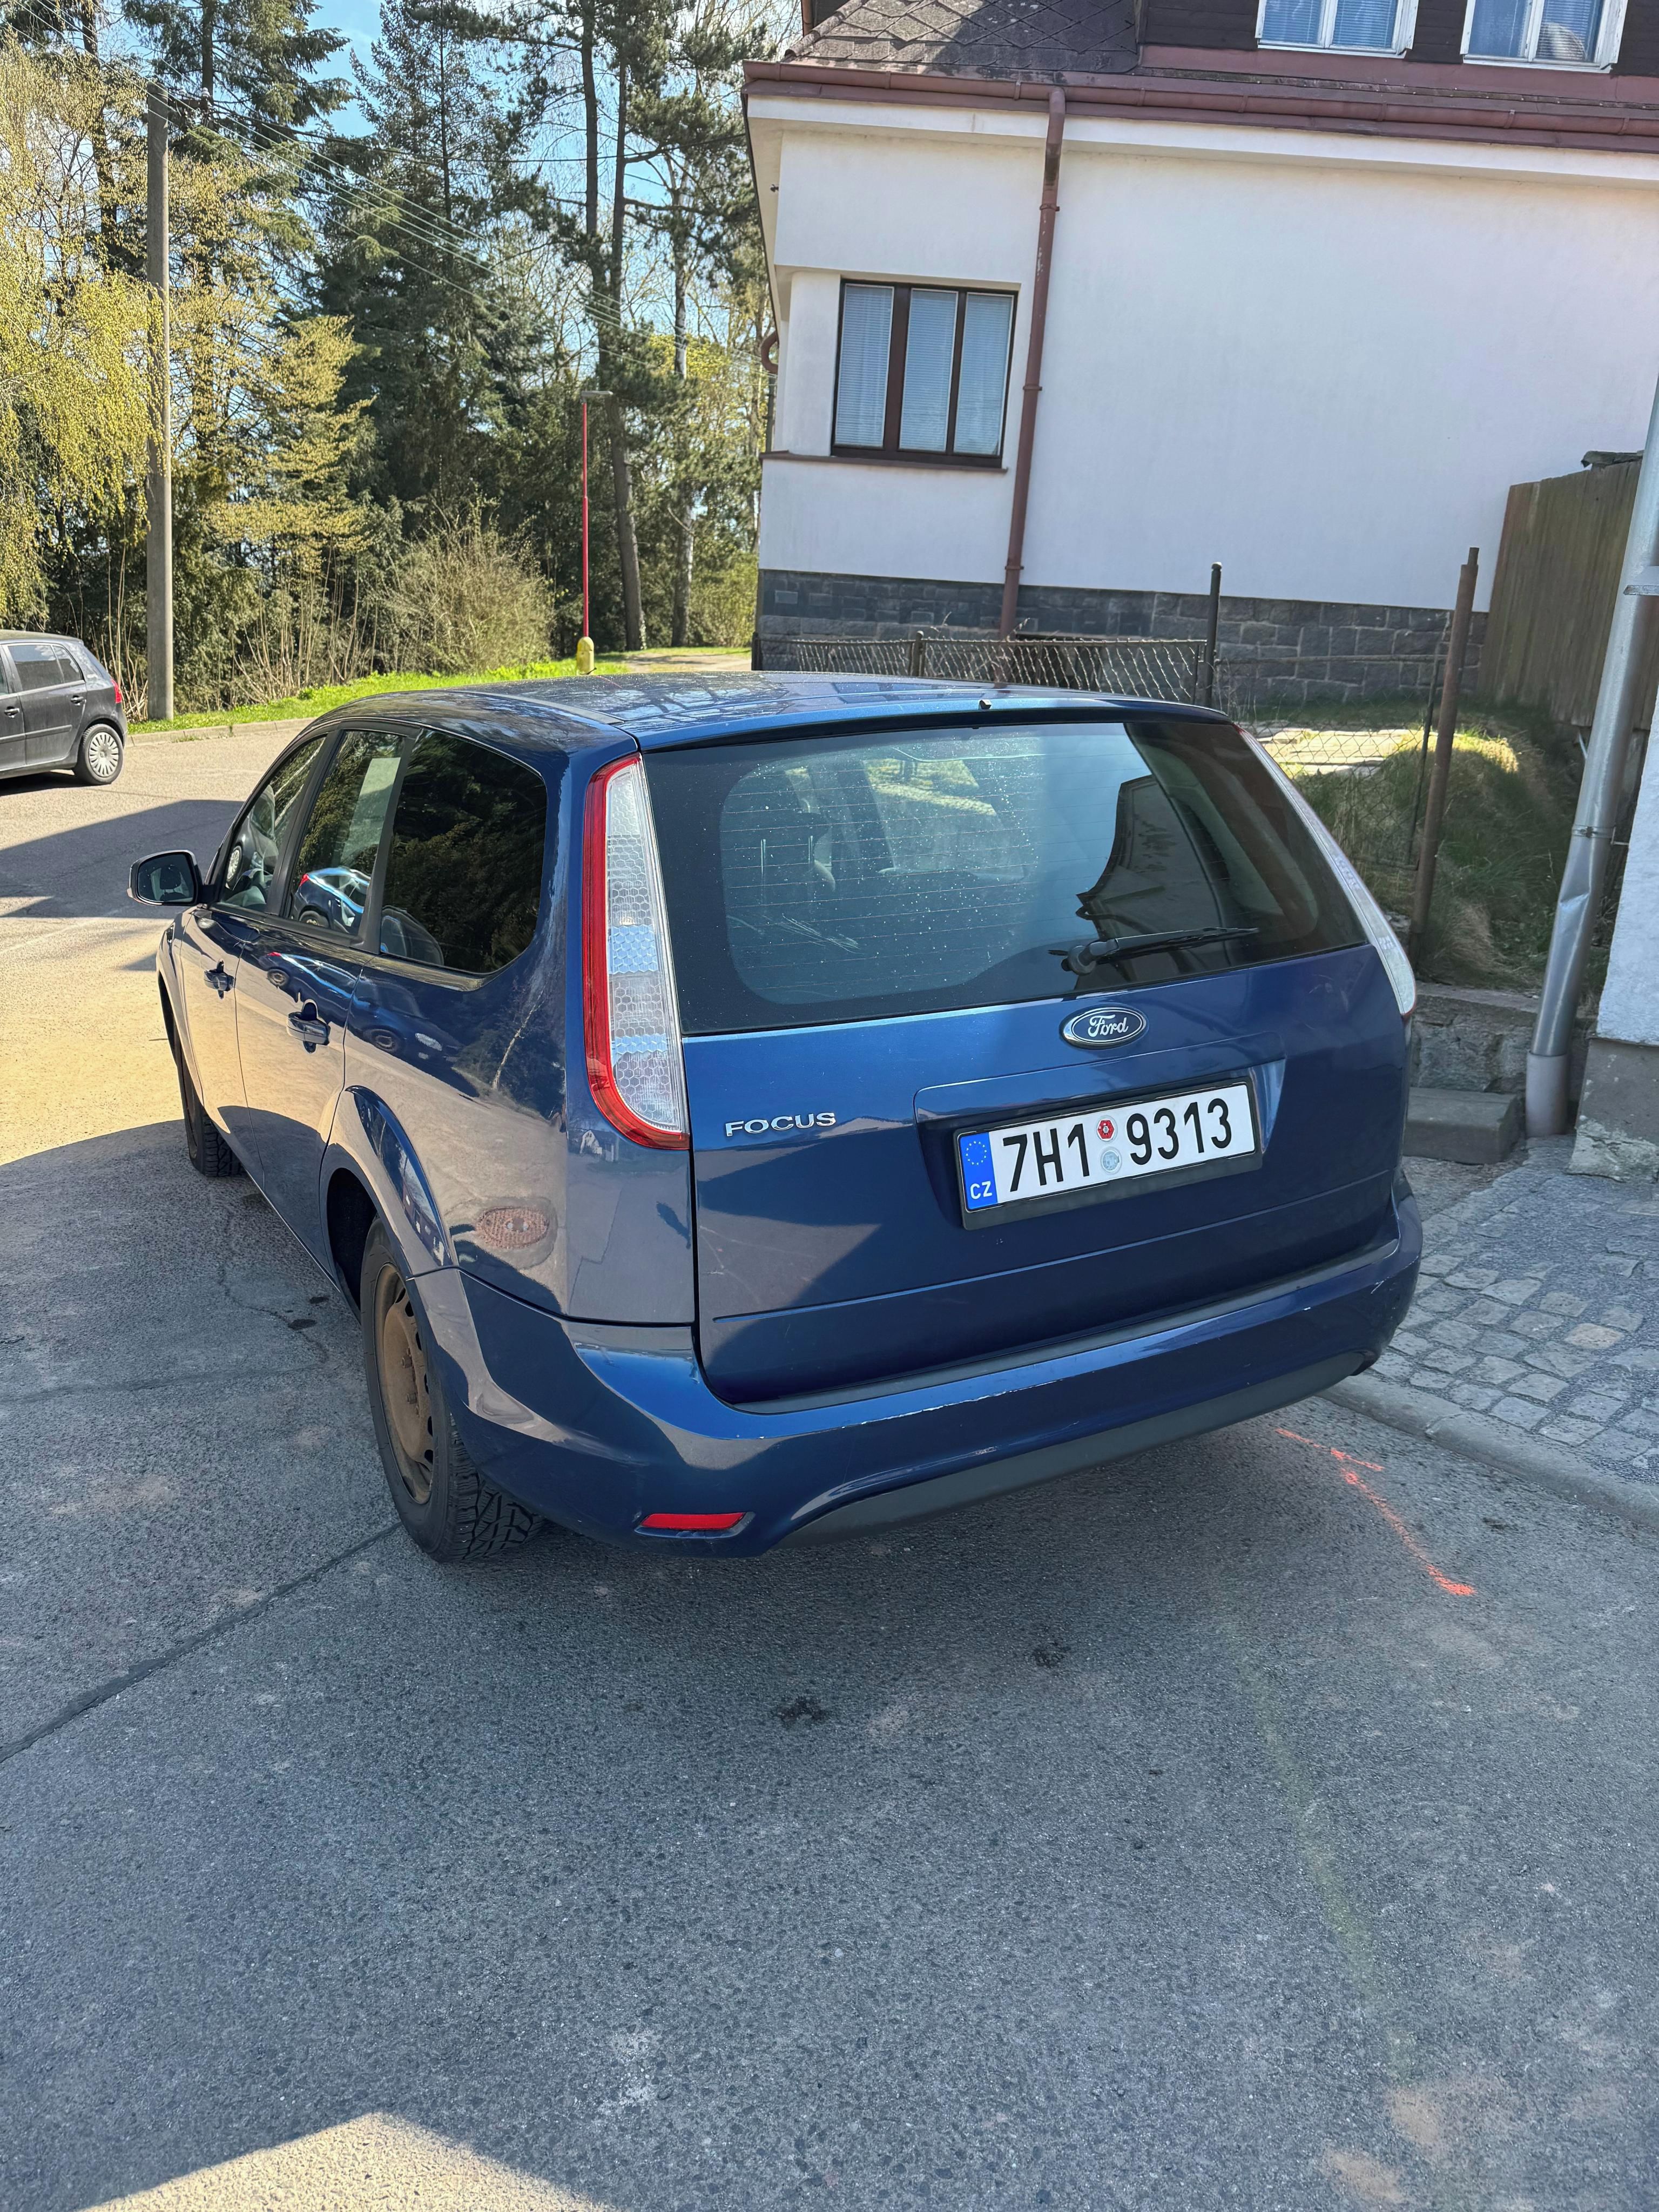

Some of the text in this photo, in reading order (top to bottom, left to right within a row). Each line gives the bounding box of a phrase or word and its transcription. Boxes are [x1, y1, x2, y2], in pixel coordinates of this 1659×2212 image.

[1088, 1014, 1129, 1037] Ford
[725, 1112, 836, 1137] FOCUS
[1003, 1097, 1232, 1192] 7H1 9313
[970, 1181, 993, 1199] CZ
